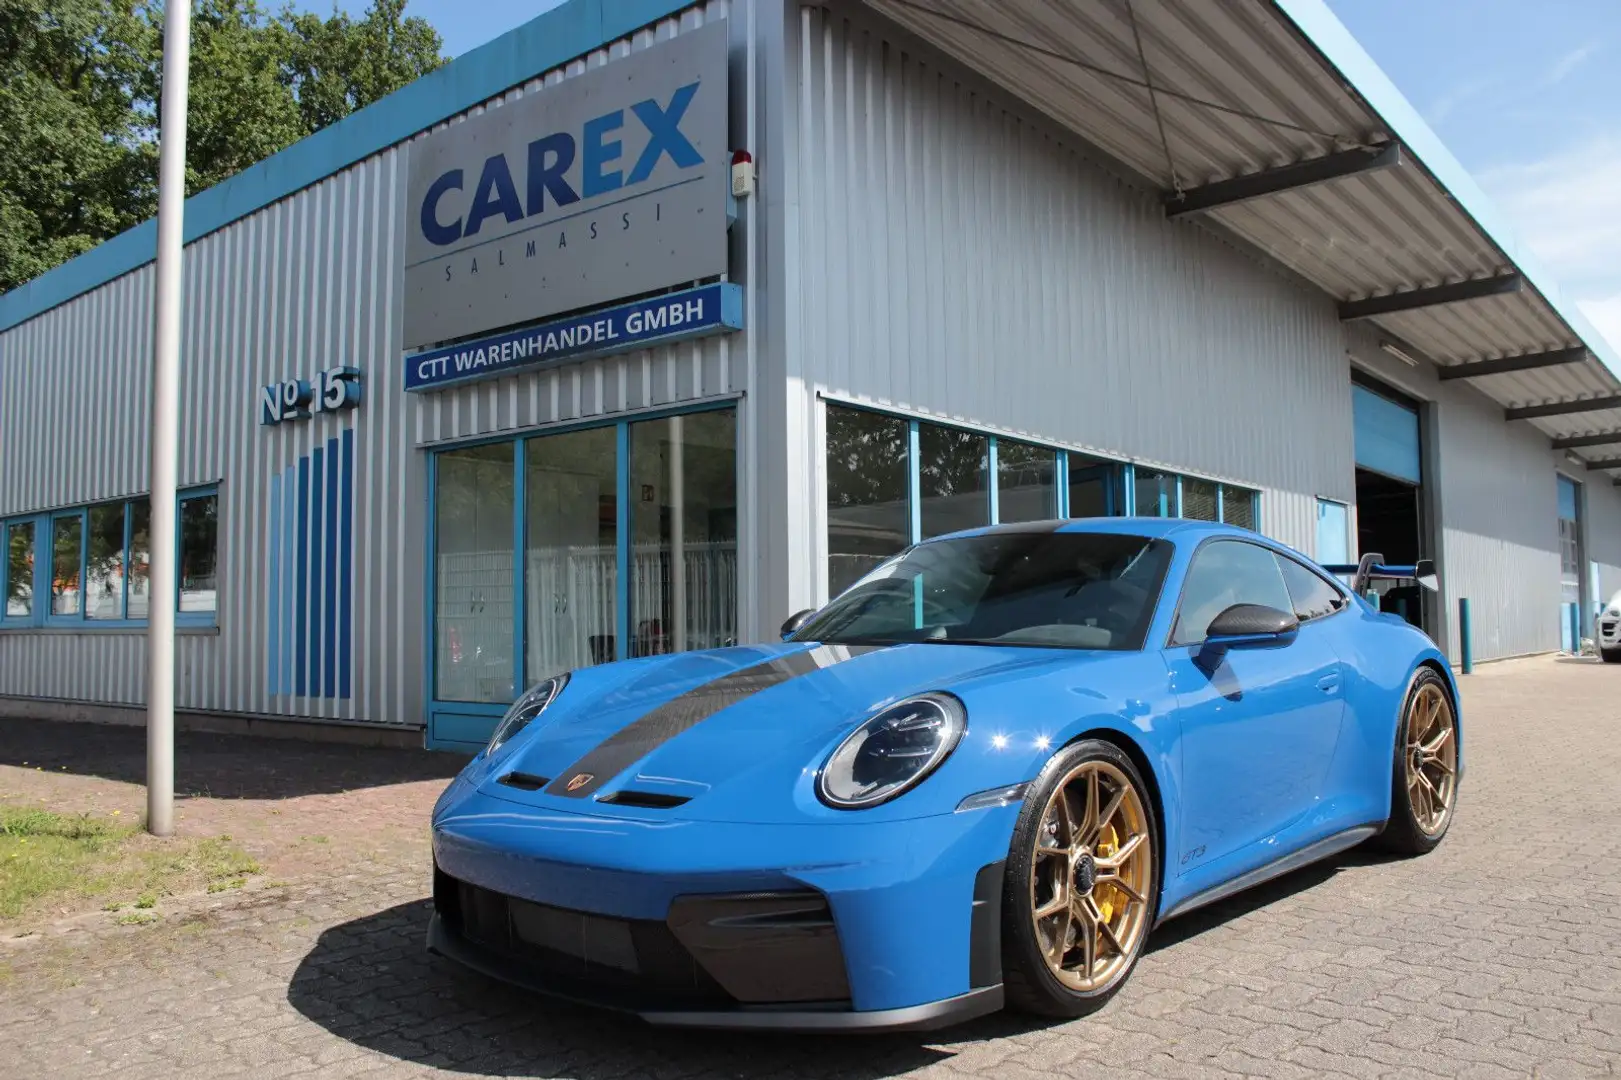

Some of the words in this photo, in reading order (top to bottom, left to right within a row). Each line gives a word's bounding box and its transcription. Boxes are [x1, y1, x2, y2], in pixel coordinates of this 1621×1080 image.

[420, 81, 705, 246] CAREX
[445, 203, 661, 281] SALMASSI
[418, 355, 450, 380] CTT
[454, 319, 619, 372] WARENHANDEL
[625, 298, 704, 335] GMBH
[311, 366, 346, 413] 15
